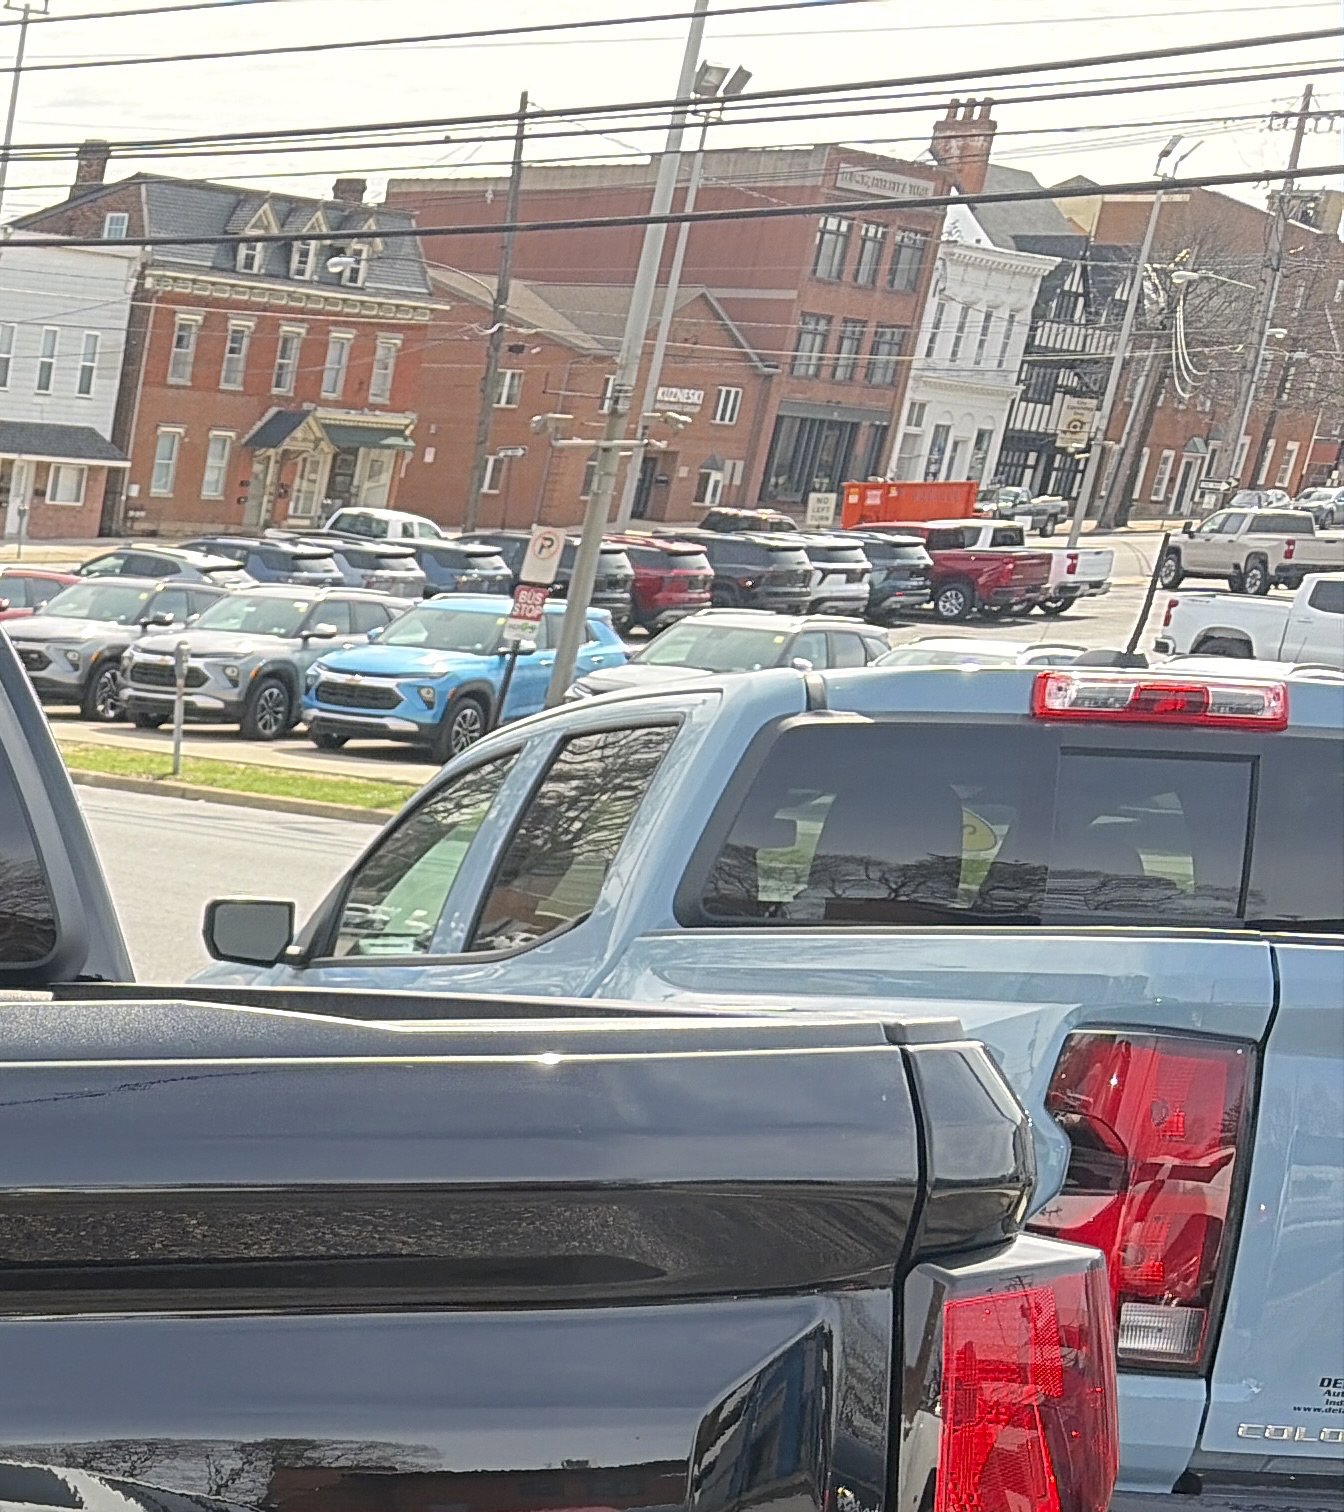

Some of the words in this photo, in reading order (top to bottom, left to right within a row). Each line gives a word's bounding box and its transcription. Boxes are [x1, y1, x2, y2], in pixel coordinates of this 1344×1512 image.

[816, 496, 830, 505] NO
[518, 590, 543, 605] BUS
[512, 603, 542, 618] STOP
